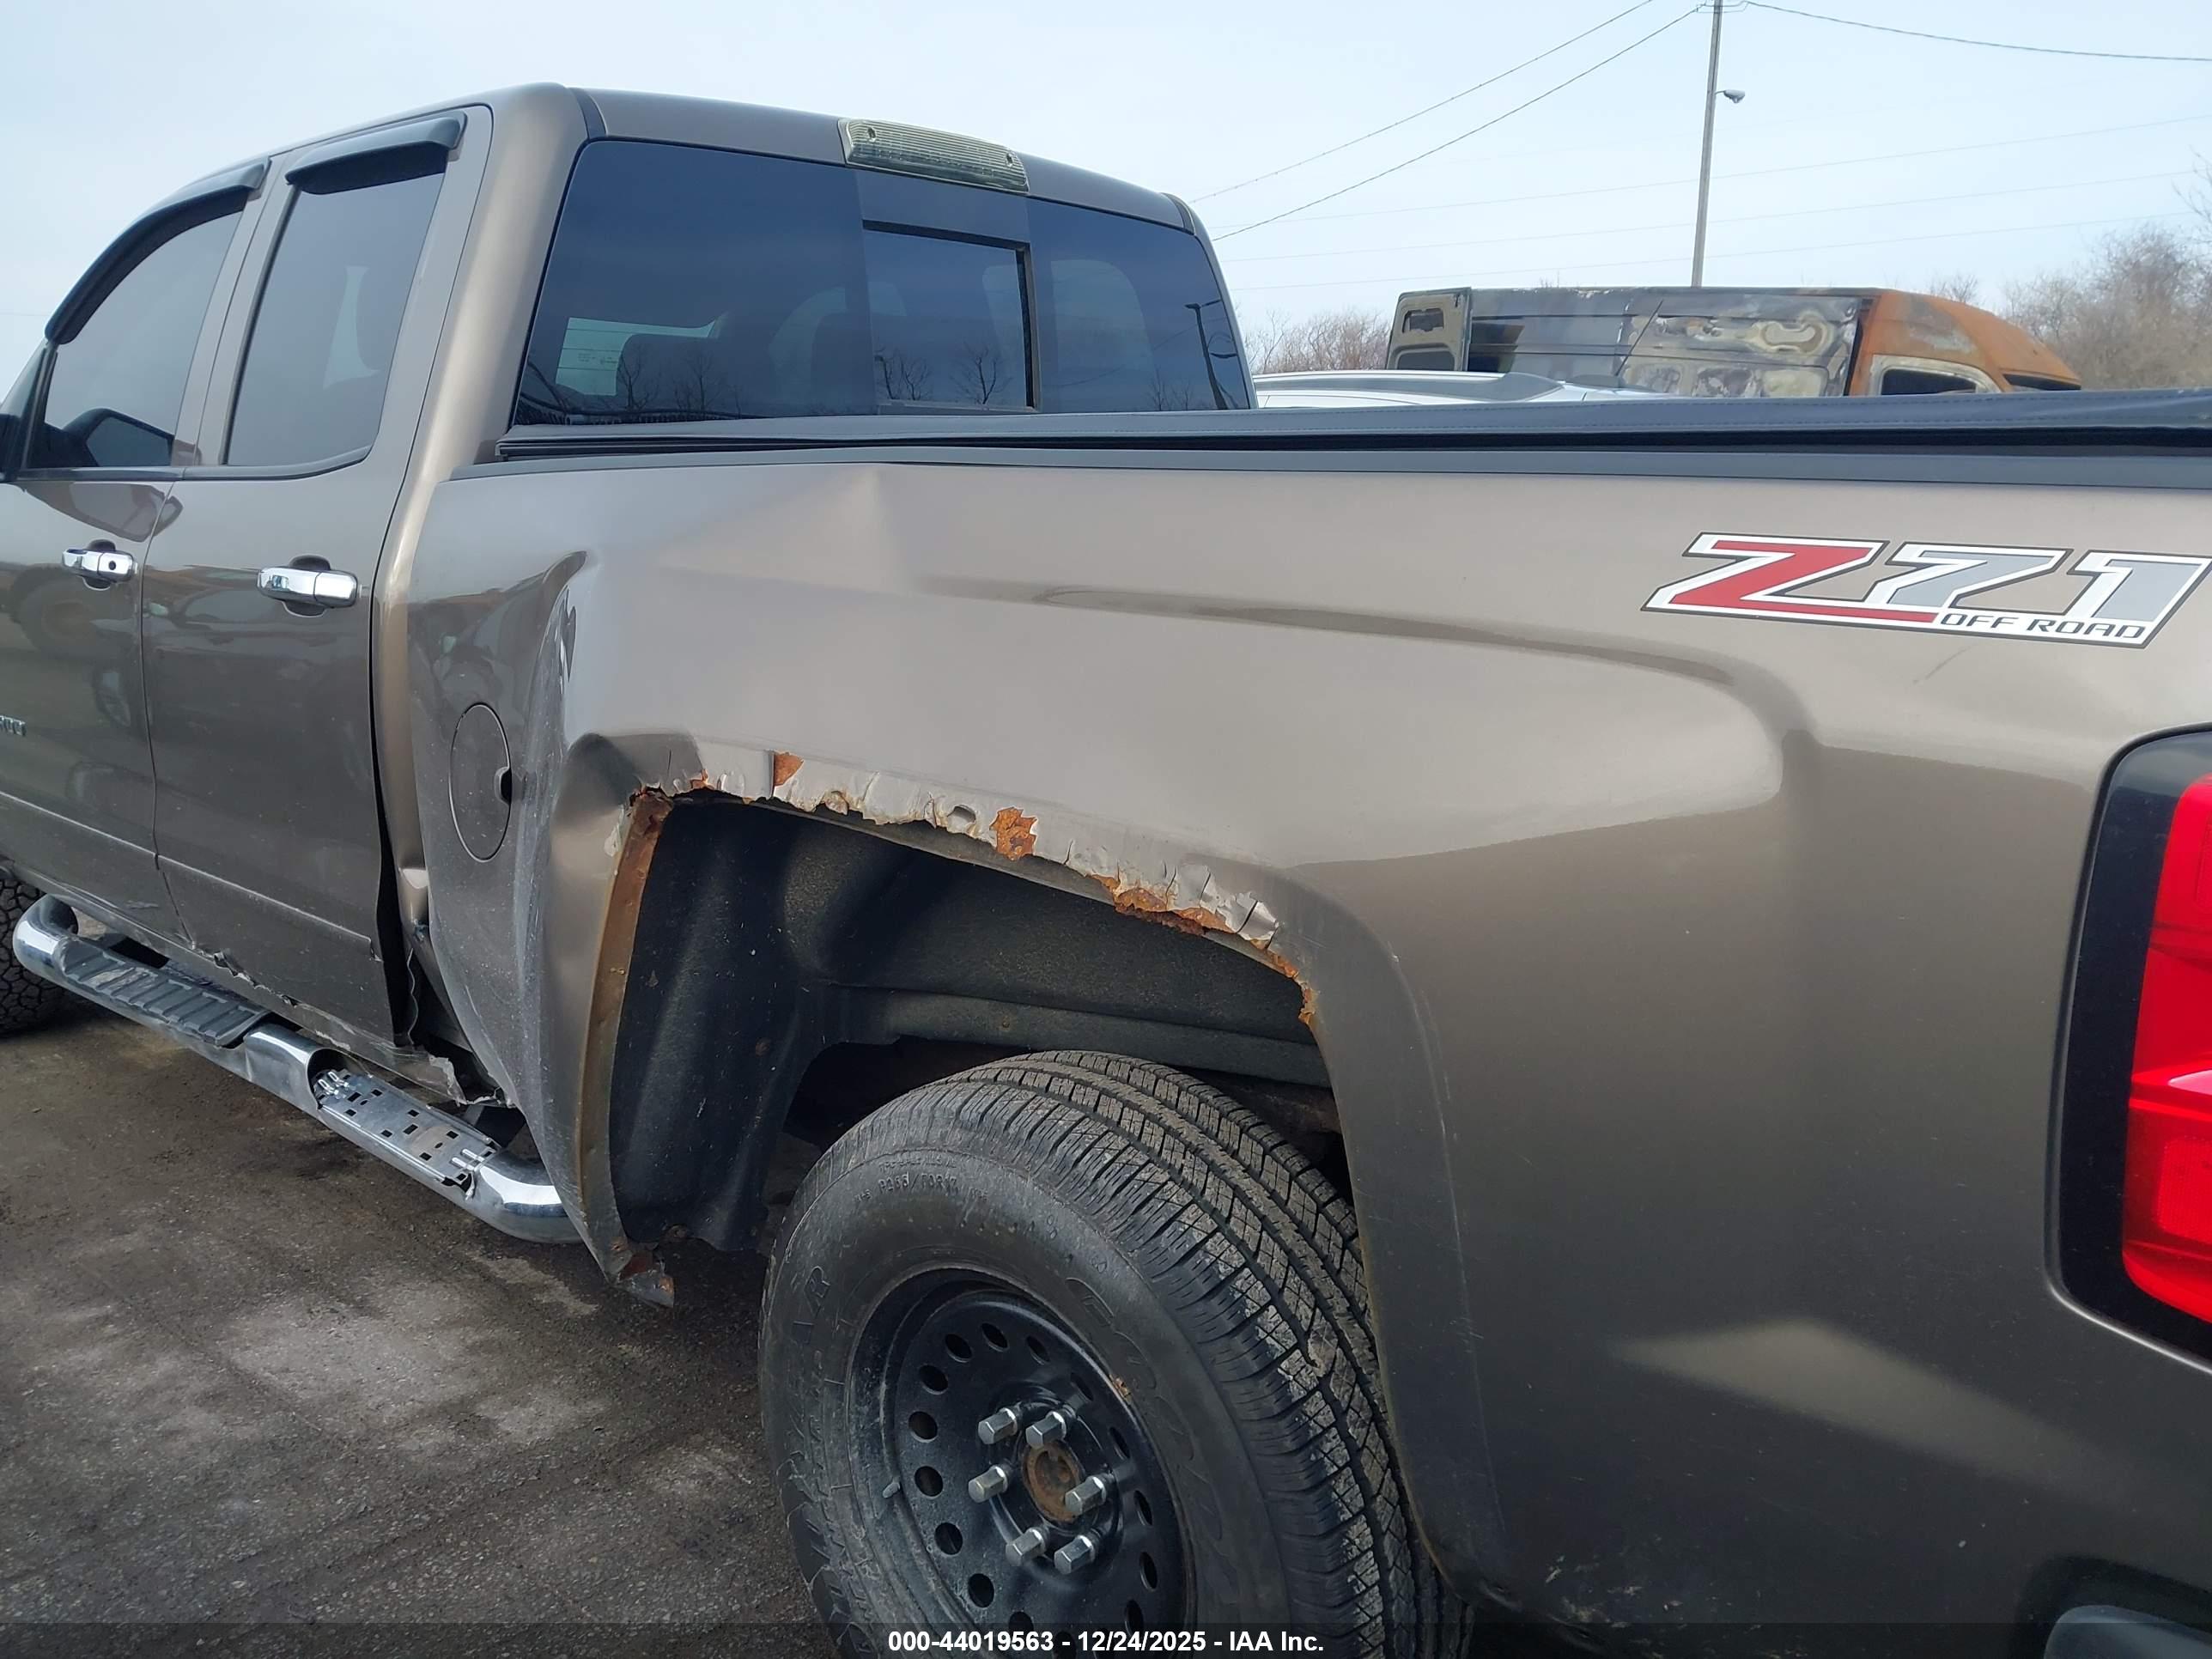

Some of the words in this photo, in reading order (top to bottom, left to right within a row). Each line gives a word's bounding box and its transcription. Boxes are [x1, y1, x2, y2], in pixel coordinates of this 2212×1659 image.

[1641, 532, 2212, 637] Z71
[1940, 612, 2020, 629] OFF
[2026, 618, 2147, 640] ROAD
